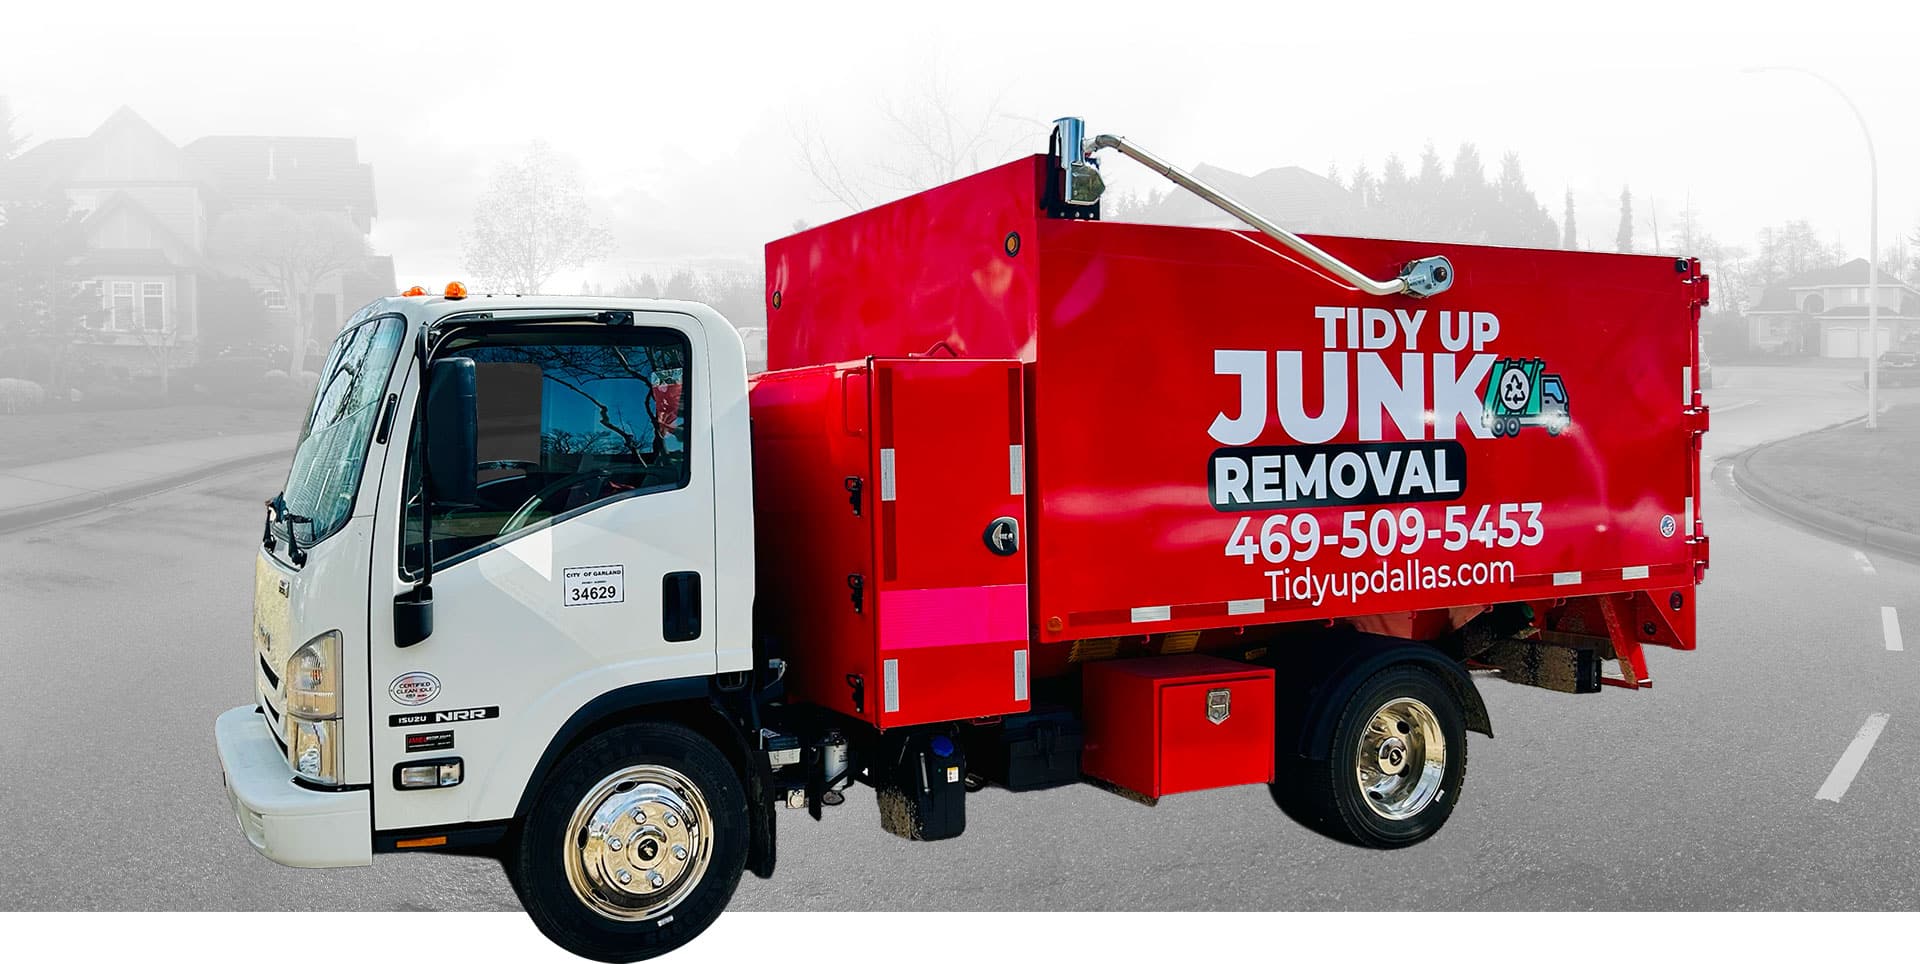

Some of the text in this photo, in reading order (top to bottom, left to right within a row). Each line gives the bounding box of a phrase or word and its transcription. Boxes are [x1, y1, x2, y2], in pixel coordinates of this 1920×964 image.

[1315, 306, 1500, 351] TIDY UP
[1207, 350, 1498, 445] JUNK
[1214, 449, 1460, 505] REMOVAL
[1225, 503, 1543, 565] 469-509-5453
[572, 585, 616, 601] 34629
[1264, 558, 1514, 606] Tidyupdallas.com
[398, 709, 486, 724] ISUZU NRR
